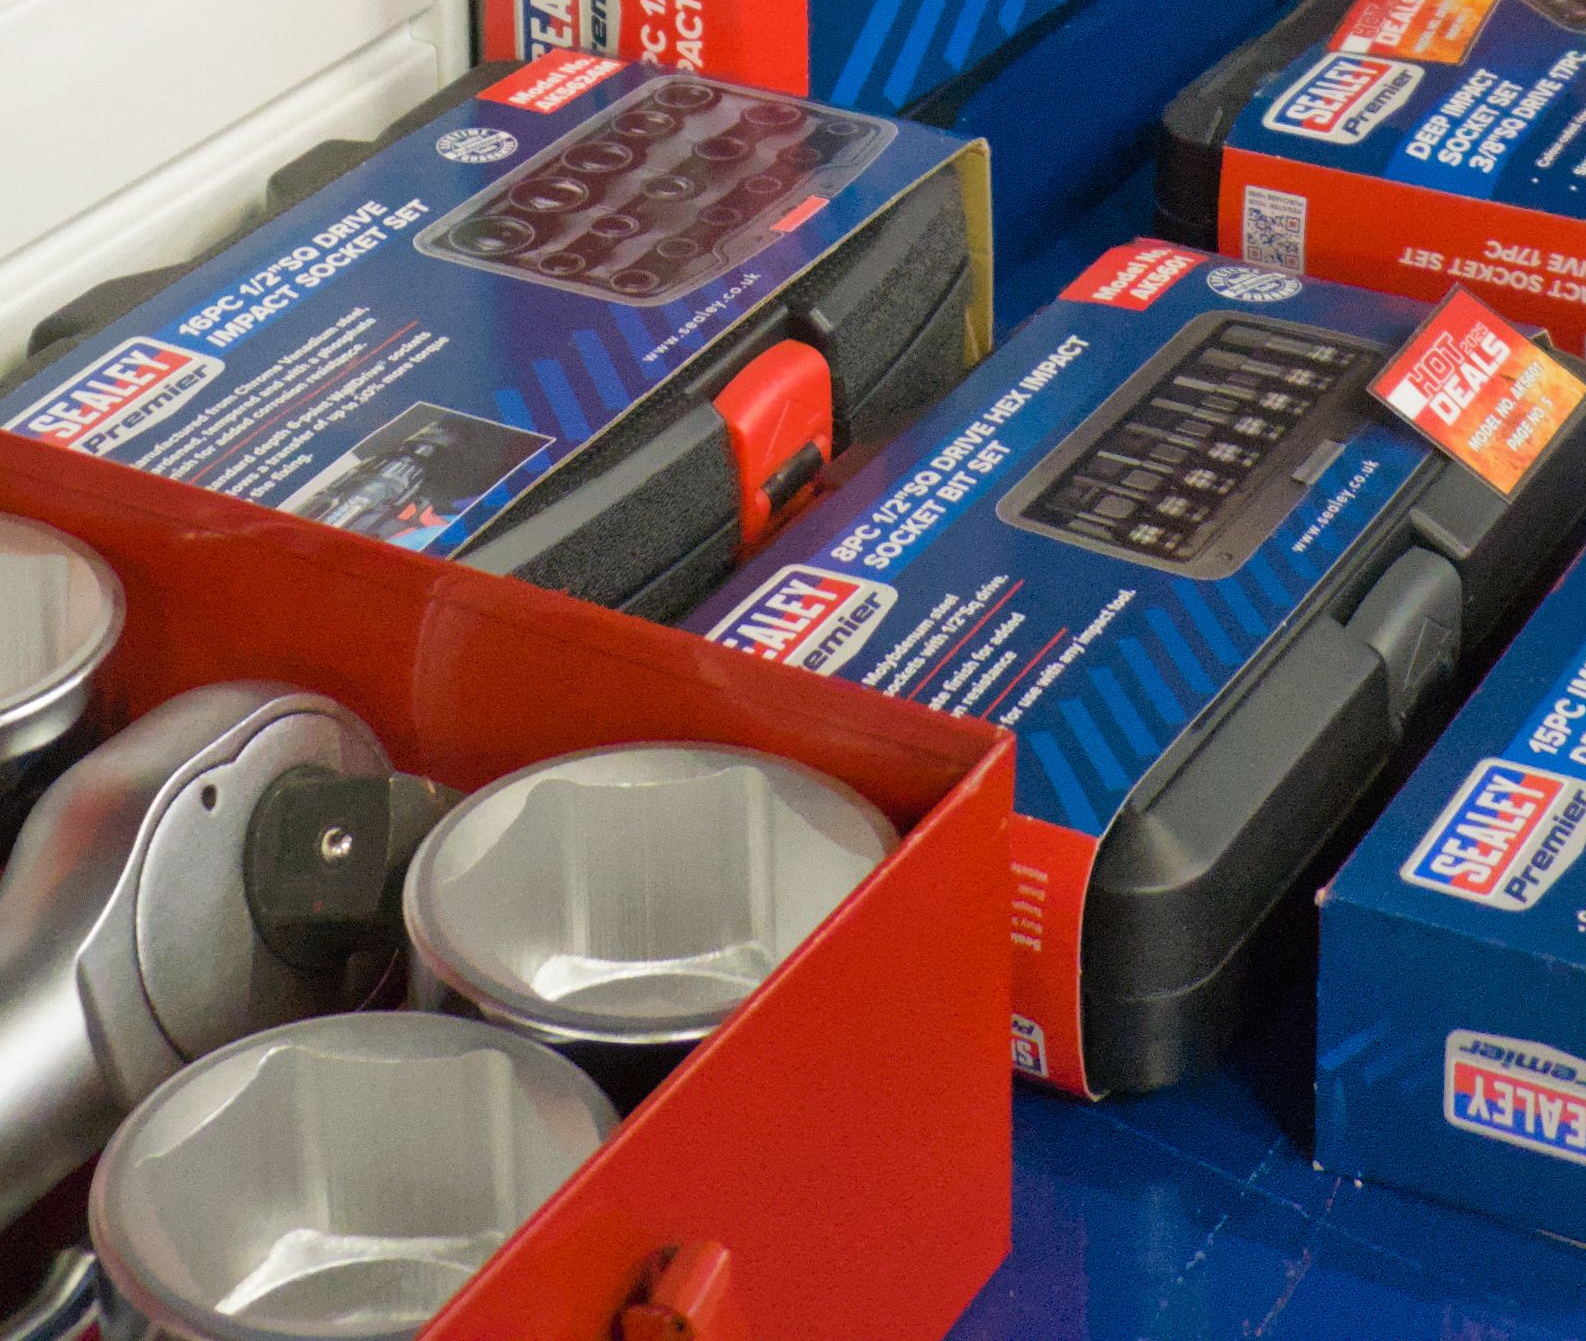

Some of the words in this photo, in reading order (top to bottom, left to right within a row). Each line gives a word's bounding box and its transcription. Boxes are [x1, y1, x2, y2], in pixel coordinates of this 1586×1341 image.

[509, 73, 565, 104] Model
[558, 56, 595, 80] No.
[1285, 60, 1379, 125] SEALEY
[1344, 68, 1412, 136] Premier
[1405, 116, 1448, 162] DEEP
[1438, 68, 1499, 122] IMPACT
[1437, 107, 1503, 168] SOCKET
[1494, 80, 1524, 114] SET
[1468, 118, 1527, 174] 3/8"SQ
[1512, 79, 1565, 129] DRIVE
[179, 296, 244, 339] 16PC
[240, 245, 317, 296] 1/2"SQ
[313, 200, 388, 248] DRIVE
[206, 285, 300, 348] IMPACT
[295, 227, 389, 287] SOCKET
[382, 198, 430, 231] SET
[1091, 255, 1148, 302] Model
[1142, 247, 1171, 269] No.
[1129, 254, 1196, 302] AK5601
[1399, 246, 1444, 270] SET
[1447, 256, 1543, 294] SOCKET
[1484, 240, 1540, 268] 17PC
[642, 271, 761, 363] www.sealey.co.uk
[1409, 331, 1465, 400] HOT
[1459, 325, 1489, 354] 2025
[27, 347, 172, 438] SEALEY
[82, 363, 209, 455] Premier
[1428, 333, 1512, 427] DEALS
[1467, 417, 1501, 454] MODEL
[1496, 394, 1515, 420] NO.
[1510, 361, 1544, 405] AK5601
[1506, 424, 1531, 452] PAGE
[1526, 408, 1544, 433] NO.
[1542, 396, 1553, 409] 5
[831, 525, 880, 562] 8PC
[873, 466, 941, 532] 1/2"SQ
[931, 419, 995, 474] DRIVE
[983, 386, 1031, 427] HEX
[1019, 333, 1090, 393] IMPACT
[864, 500, 946, 570] SOCKET
[937, 469, 976, 506] BIT
[970, 440, 1011, 475] SET
[1292, 458, 1379, 553] www.sealey.co.uk
[1529, 699, 1586, 755] 15PC
[1429, 774, 1546, 884] SEALEY
